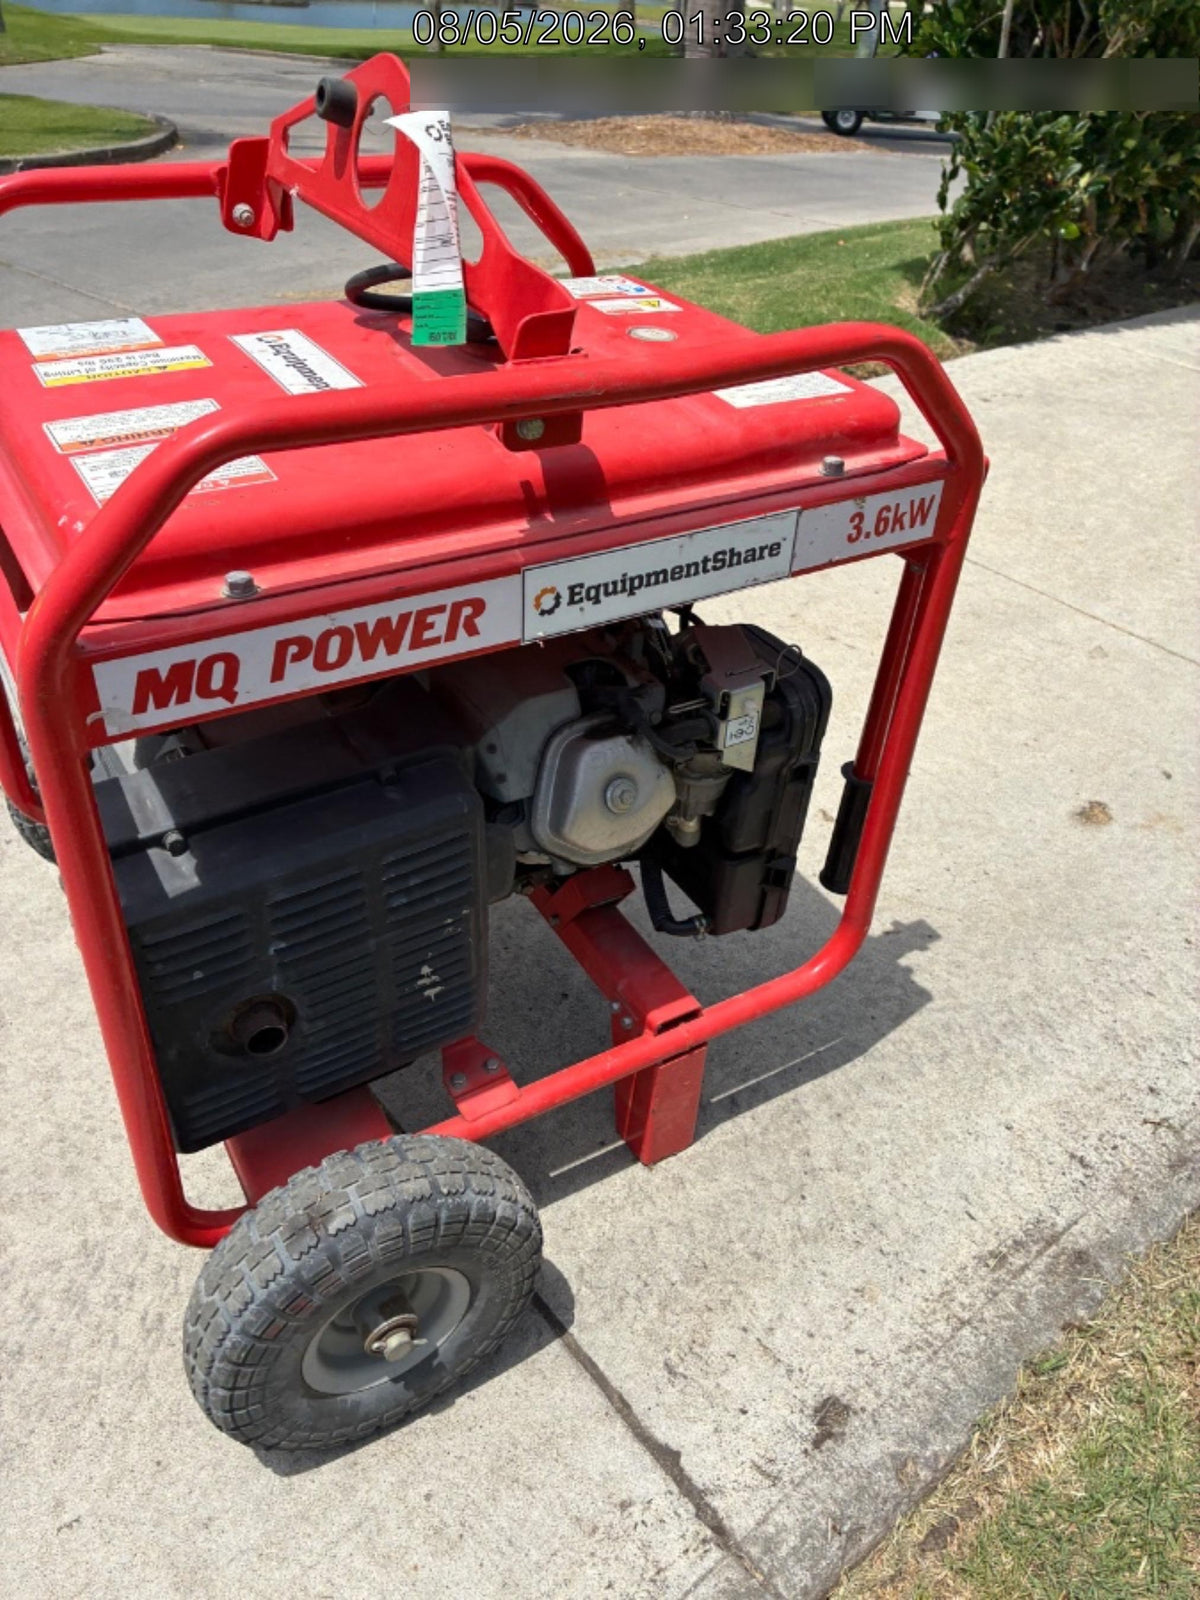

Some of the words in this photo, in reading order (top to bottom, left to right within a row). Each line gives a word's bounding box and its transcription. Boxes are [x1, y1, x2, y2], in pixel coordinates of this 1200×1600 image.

[847, 494, 936, 544] 3.6kW
[566, 540, 782, 607] EquipmentShare
[131, 652, 241, 715] MQ
[269, 596, 487, 683] POWER
